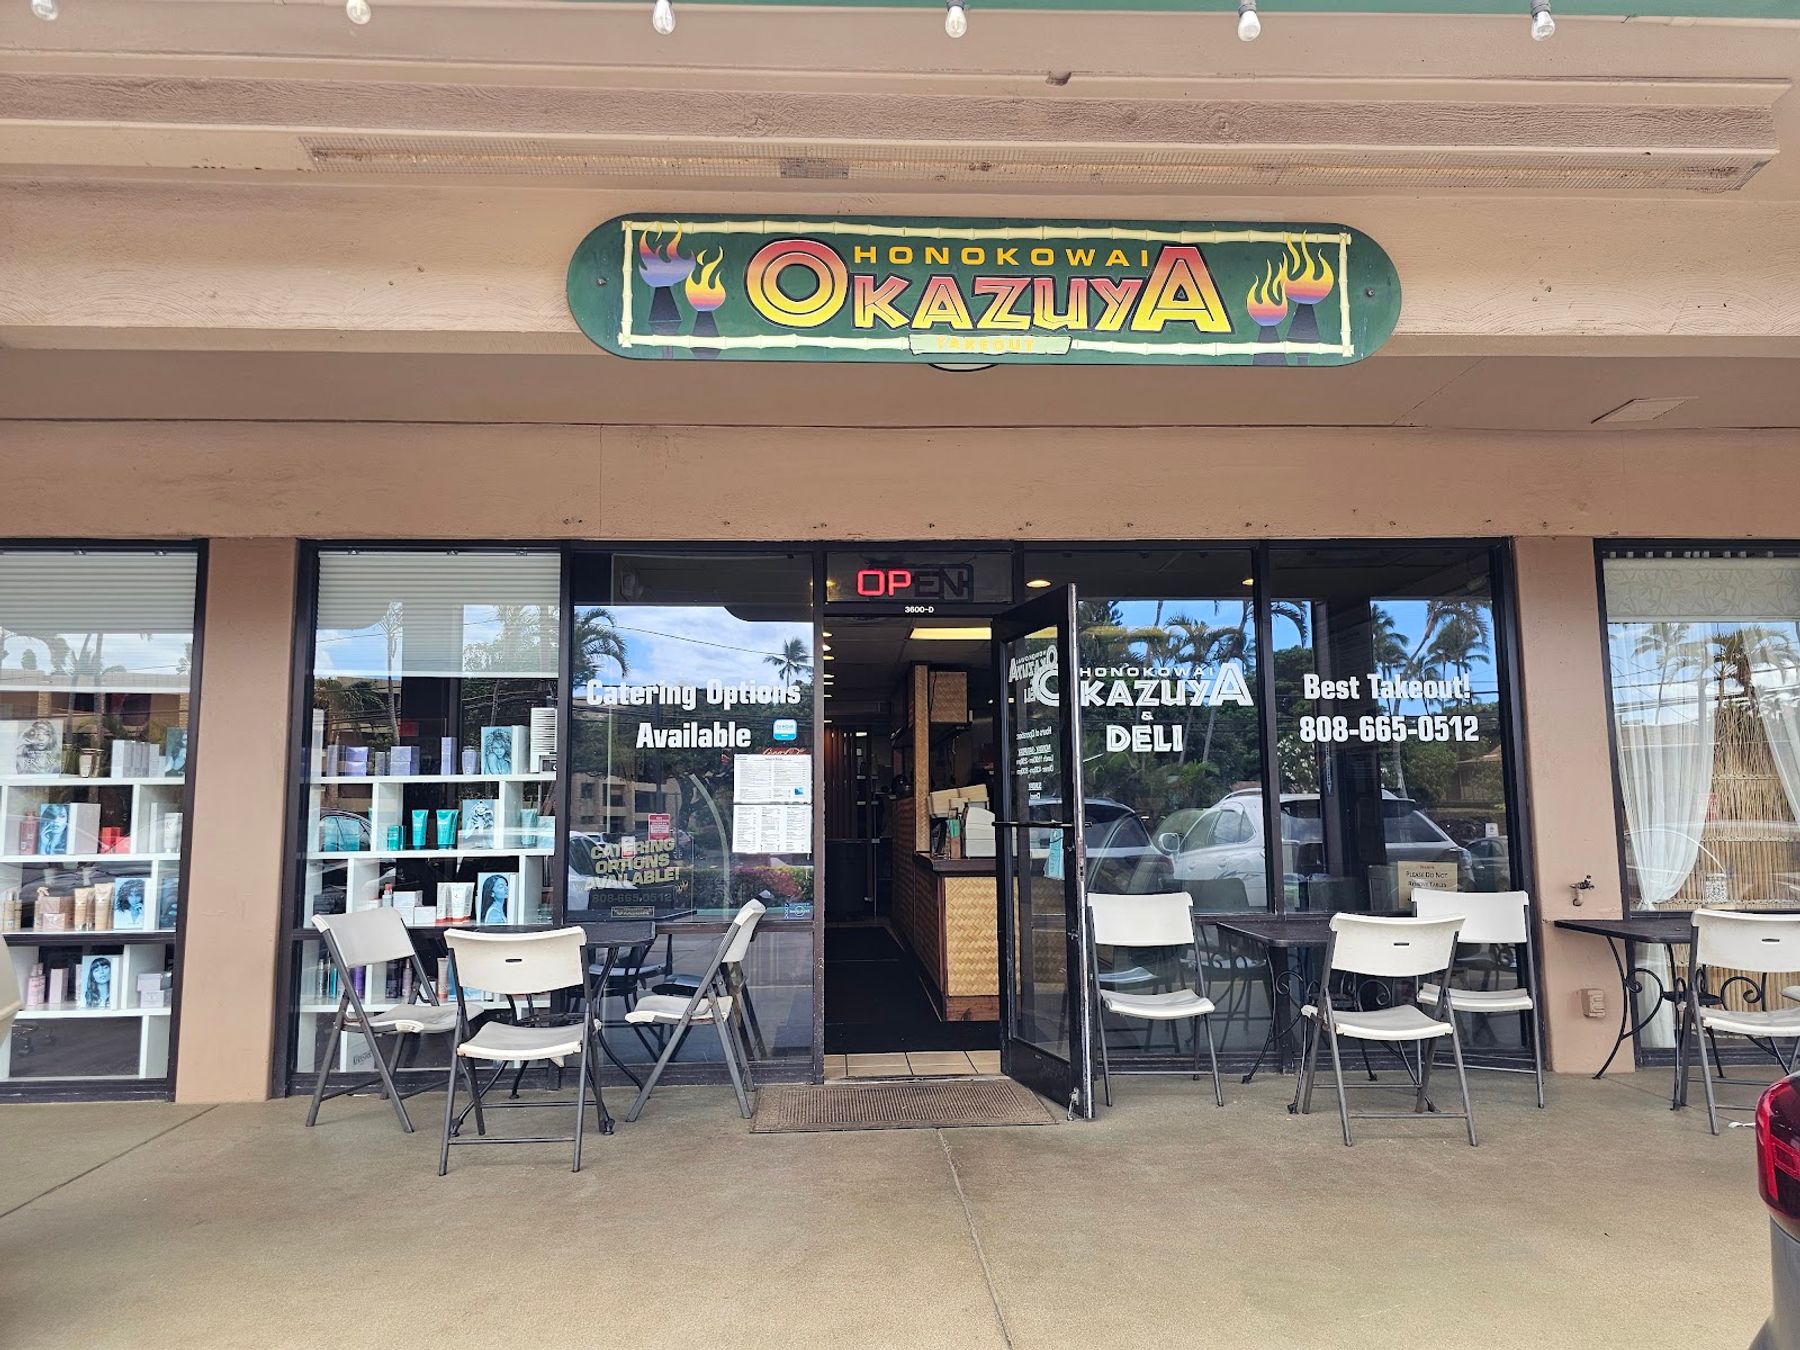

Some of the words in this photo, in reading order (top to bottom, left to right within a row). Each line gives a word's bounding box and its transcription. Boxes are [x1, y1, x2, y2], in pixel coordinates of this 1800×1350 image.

[854, 246, 1149, 267] HONOKOWAI
[744, 238, 1233, 333] OKAZUYA
[936, 335, 1035, 352] TAKEOUT
[857, 569, 966, 598] OPEN
[904, 606, 935, 614] 3600-D
[1079, 667, 1214, 677] HONOKOWAI
[586, 679, 697, 711] Catering
[706, 678, 801, 711] Options
[1303, 673, 1360, 700] Best
[1367, 673, 1472, 700] Takeout!
[1141, 711, 1154, 721] &
[635, 721, 752, 749] Available
[1106, 724, 1184, 753] DELI
[1300, 715, 1480, 743] 808-665-0512
[591, 838, 675, 860] CATRING
[595, 853, 670, 875] OPTIONS
